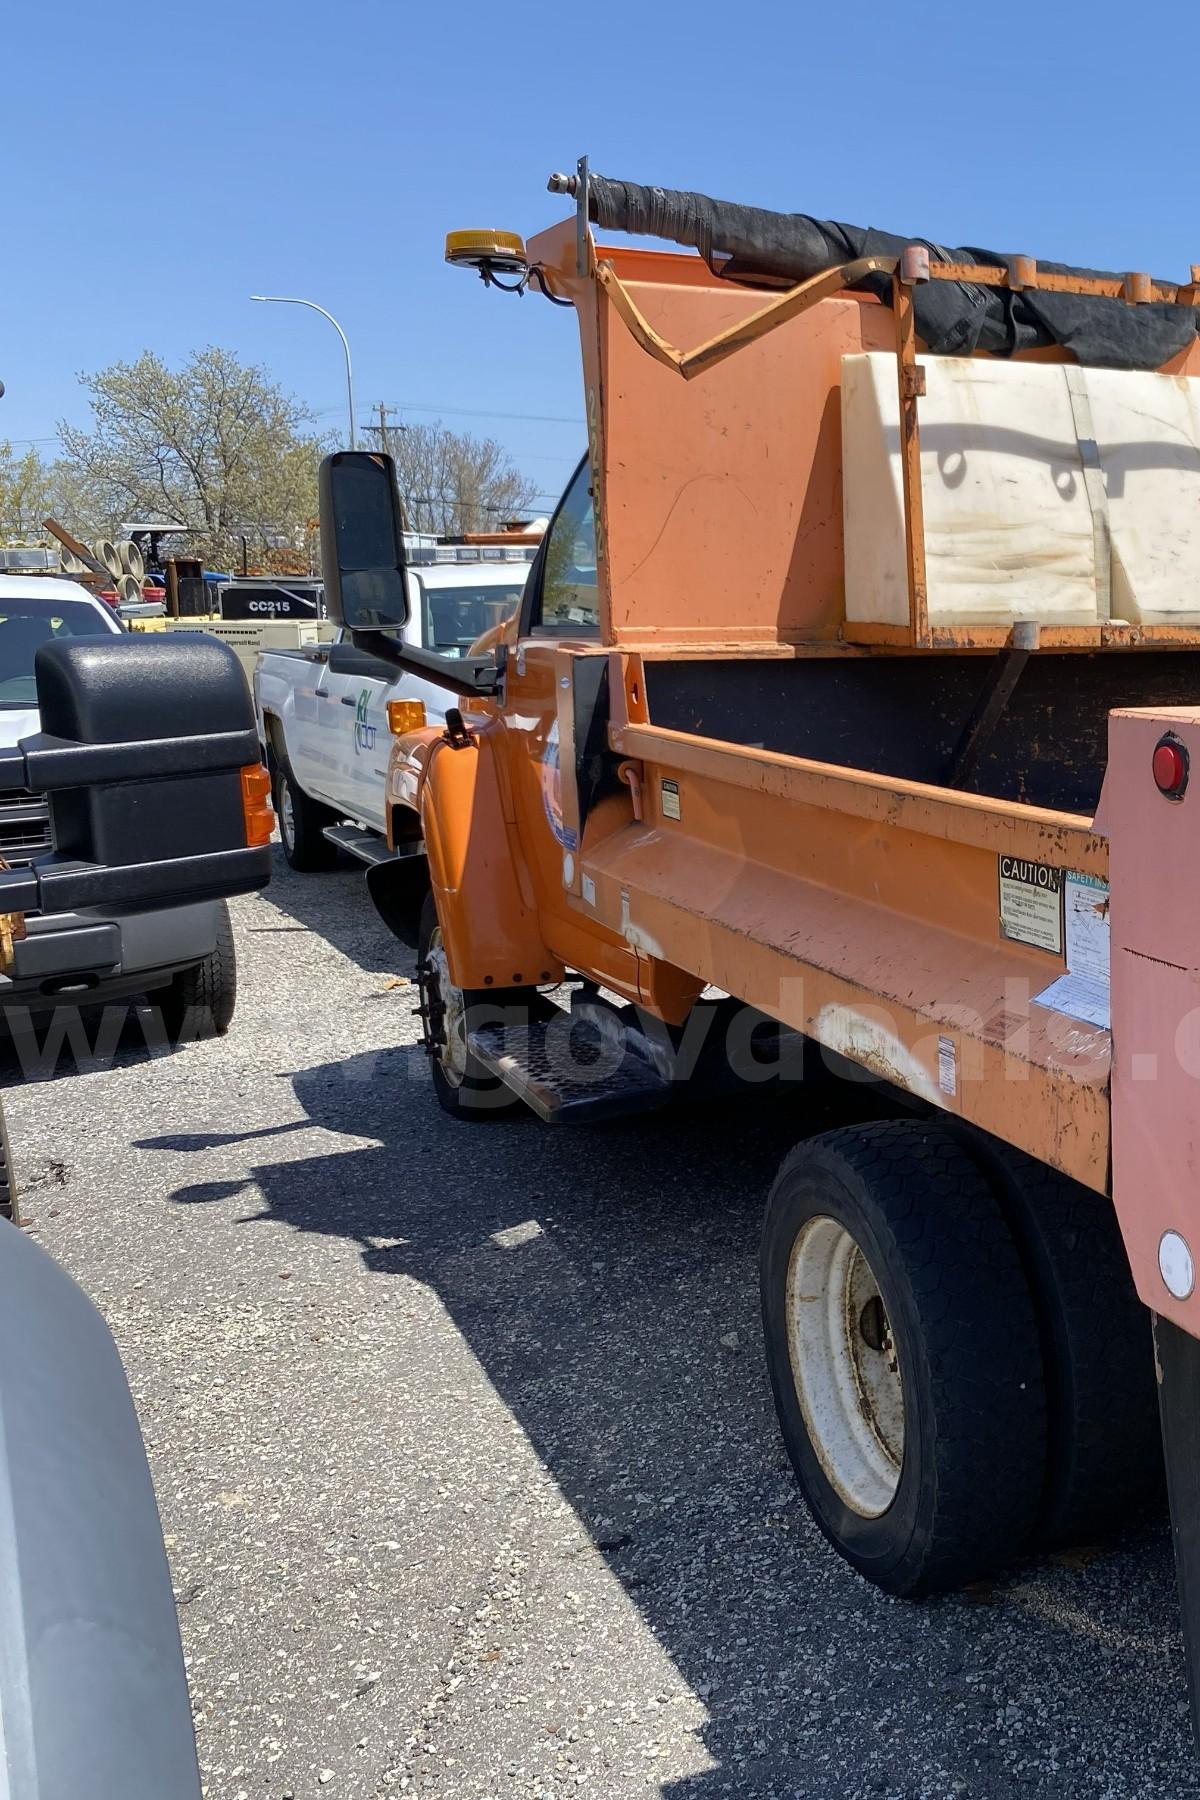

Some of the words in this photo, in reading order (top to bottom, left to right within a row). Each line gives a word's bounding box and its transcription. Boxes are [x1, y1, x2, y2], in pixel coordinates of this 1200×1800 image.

[249, 602, 290, 611] CC215
[1002, 858, 1059, 892] CAUTION
[1067, 870, 1093, 886] SAFETY
